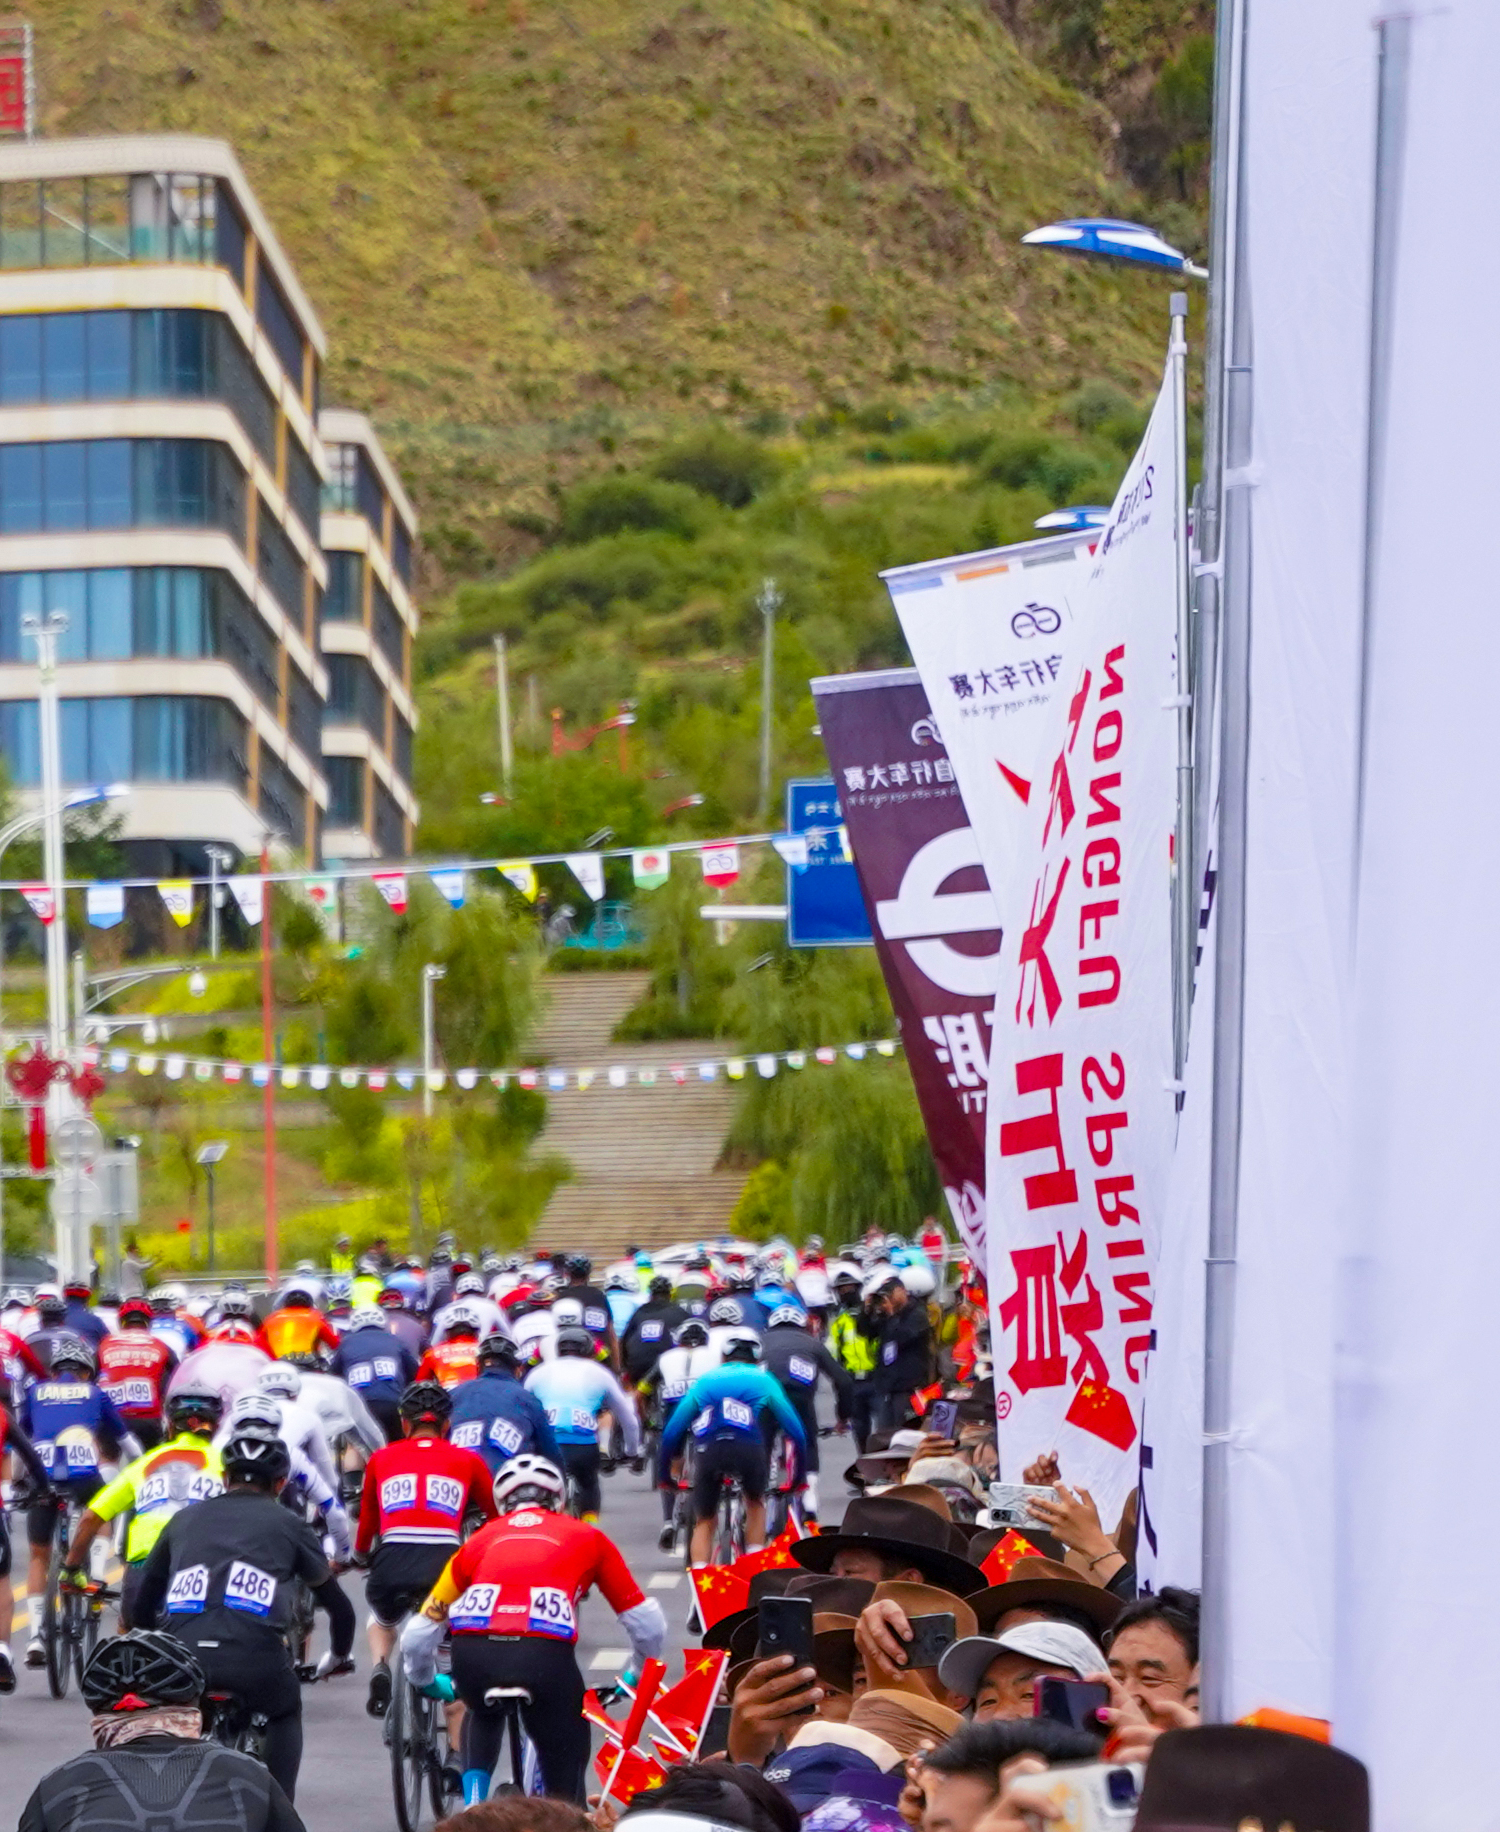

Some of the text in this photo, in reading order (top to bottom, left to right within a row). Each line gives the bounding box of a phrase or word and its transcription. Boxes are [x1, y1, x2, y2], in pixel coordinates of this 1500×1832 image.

[37, 1384, 90, 1401] LAMEDA
[452, 1422, 521, 1449] 515 515
[383, 1479, 460, 1505] 599 599
[171, 1567, 271, 1600] 486 486
[534, 1591, 571, 1623] 453
